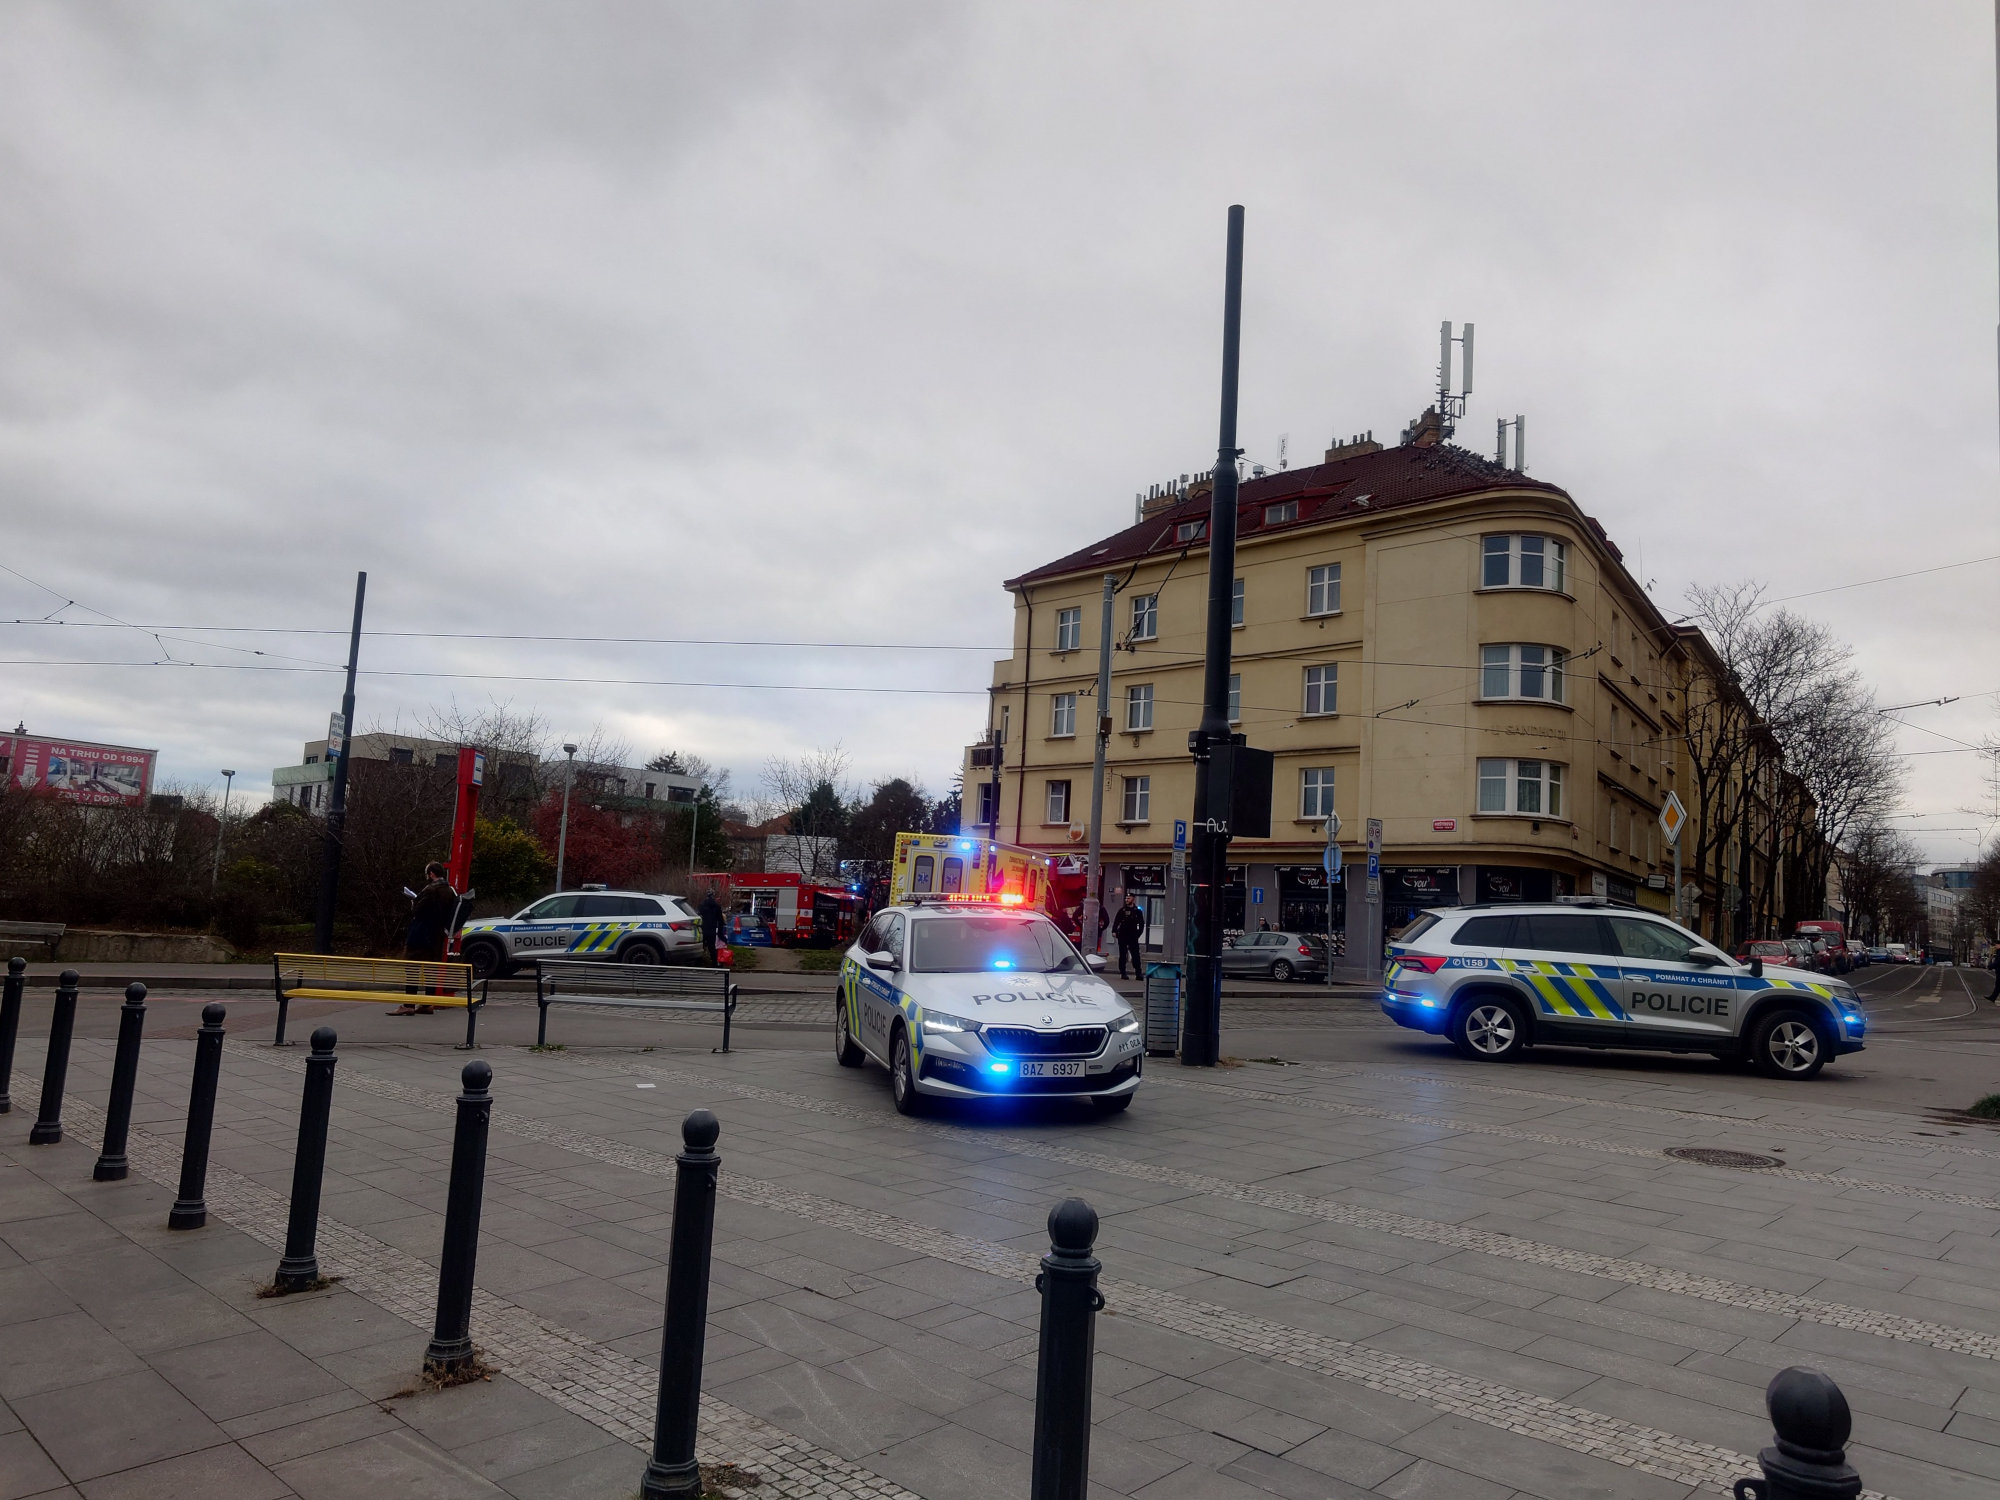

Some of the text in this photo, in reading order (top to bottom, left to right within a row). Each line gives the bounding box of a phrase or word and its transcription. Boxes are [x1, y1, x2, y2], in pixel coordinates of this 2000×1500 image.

[51, 746, 145, 764] NA TRHU OD 1994
[1176, 823, 1184, 841] P
[1369, 857, 1377, 872] P
[514, 936, 566, 947] POLICIE
[1466, 959, 1483, 967] 158
[1655, 973, 1689, 982] POMÁHAT
[1698, 976, 1729, 985] CHRÁNIT
[972, 991, 1097, 1006] POLICIE
[1631, 992, 1729, 1016] POLICIE
[863, 1003, 886, 1038] POLICIE
[1022, 1063, 1080, 1076] 8AZ 6937
